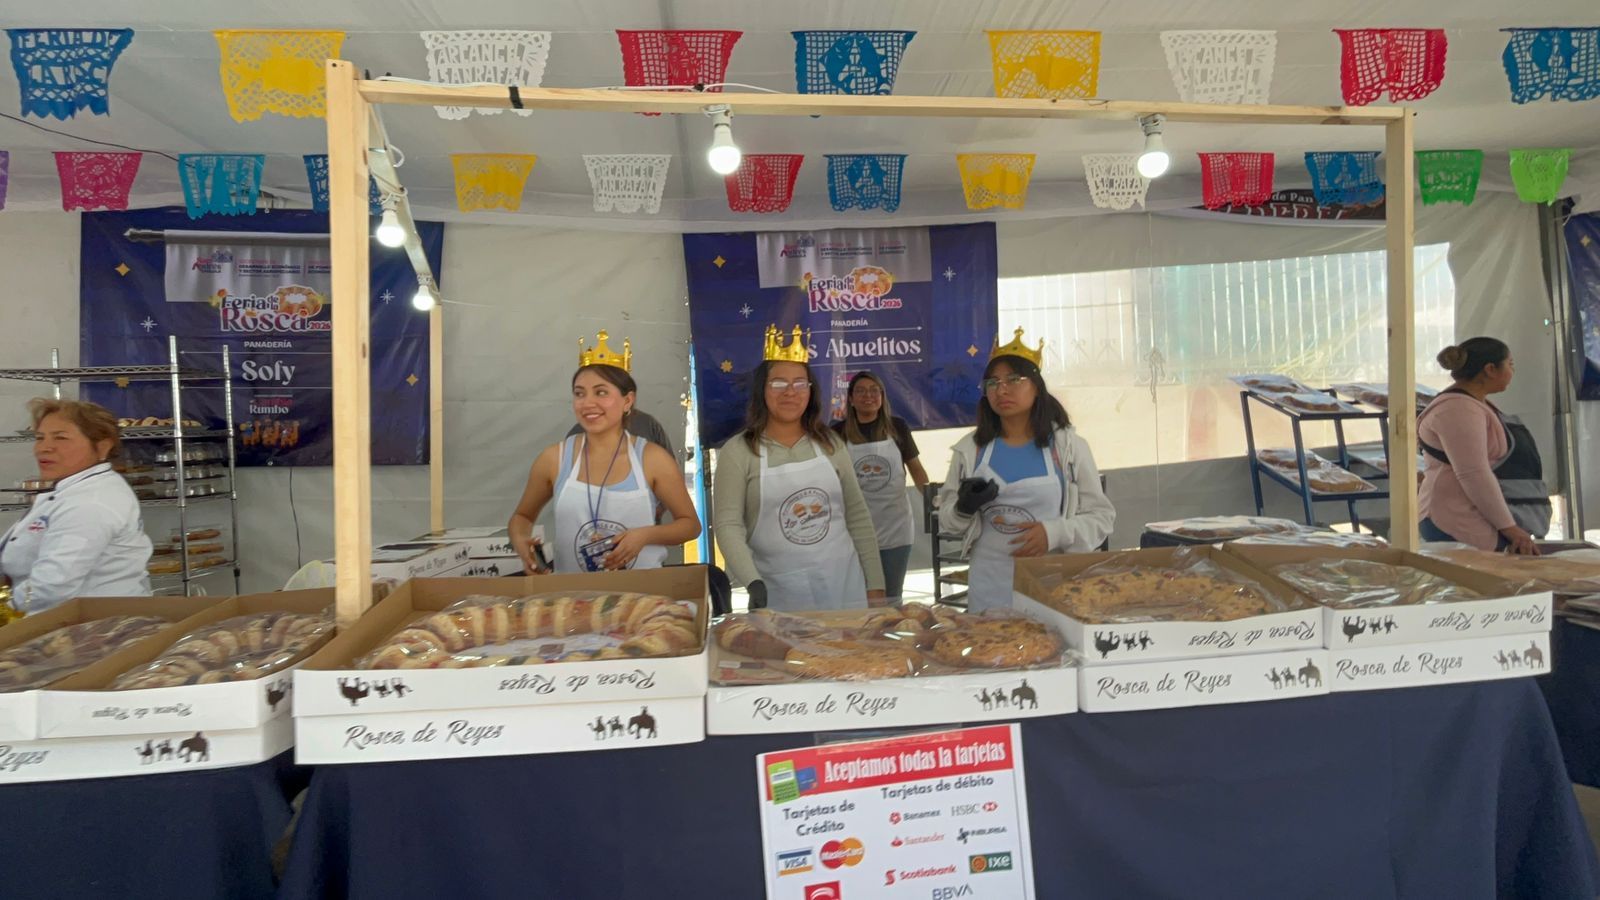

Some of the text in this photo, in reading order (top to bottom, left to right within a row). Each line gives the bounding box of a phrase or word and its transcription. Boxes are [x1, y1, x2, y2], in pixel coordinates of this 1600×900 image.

[1272, 192, 1315, 204] de Pan
[809, 275, 844, 291] Feria
[221, 293, 267, 310] Feria
[809, 287, 880, 312] Rosca
[221, 306, 332, 332] Rosca 2026
[830, 317, 868, 327] PANADERÍA
[243, 339, 292, 349] PANADERÍA
[825, 337, 921, 358] Abuelitos
[241, 360, 296, 386] Sofy
[249, 404, 289, 414] Rumbo
[1428, 604, 1547, 631] Rosca de Reyes
[1187, 620, 1316, 648] Rosca de Reyes
[1336, 652, 1464, 679] Rosca de Reyes
[499, 669, 657, 695] Rosca de Reyes
[1097, 670, 1233, 700] Rosca de Reyes
[752, 691, 899, 721] Rosca de Reyes
[342, 719, 505, 751] Rosca de Reyes
[824, 741, 1006, 784] Aceptamos todas la tarjetas
[881, 775, 994, 800] Tarjetas de débito
[782, 800, 855, 822] Tarjetas de
[903, 808, 940, 821] Banamex
[950, 802, 980, 817] HSBC
[796, 820, 844, 837] Crédito
[904, 832, 945, 846] Santander
[783, 855, 808, 870] VISA
[900, 864, 957, 881] Scotiabank
[931, 883, 974, 900] BBVA
